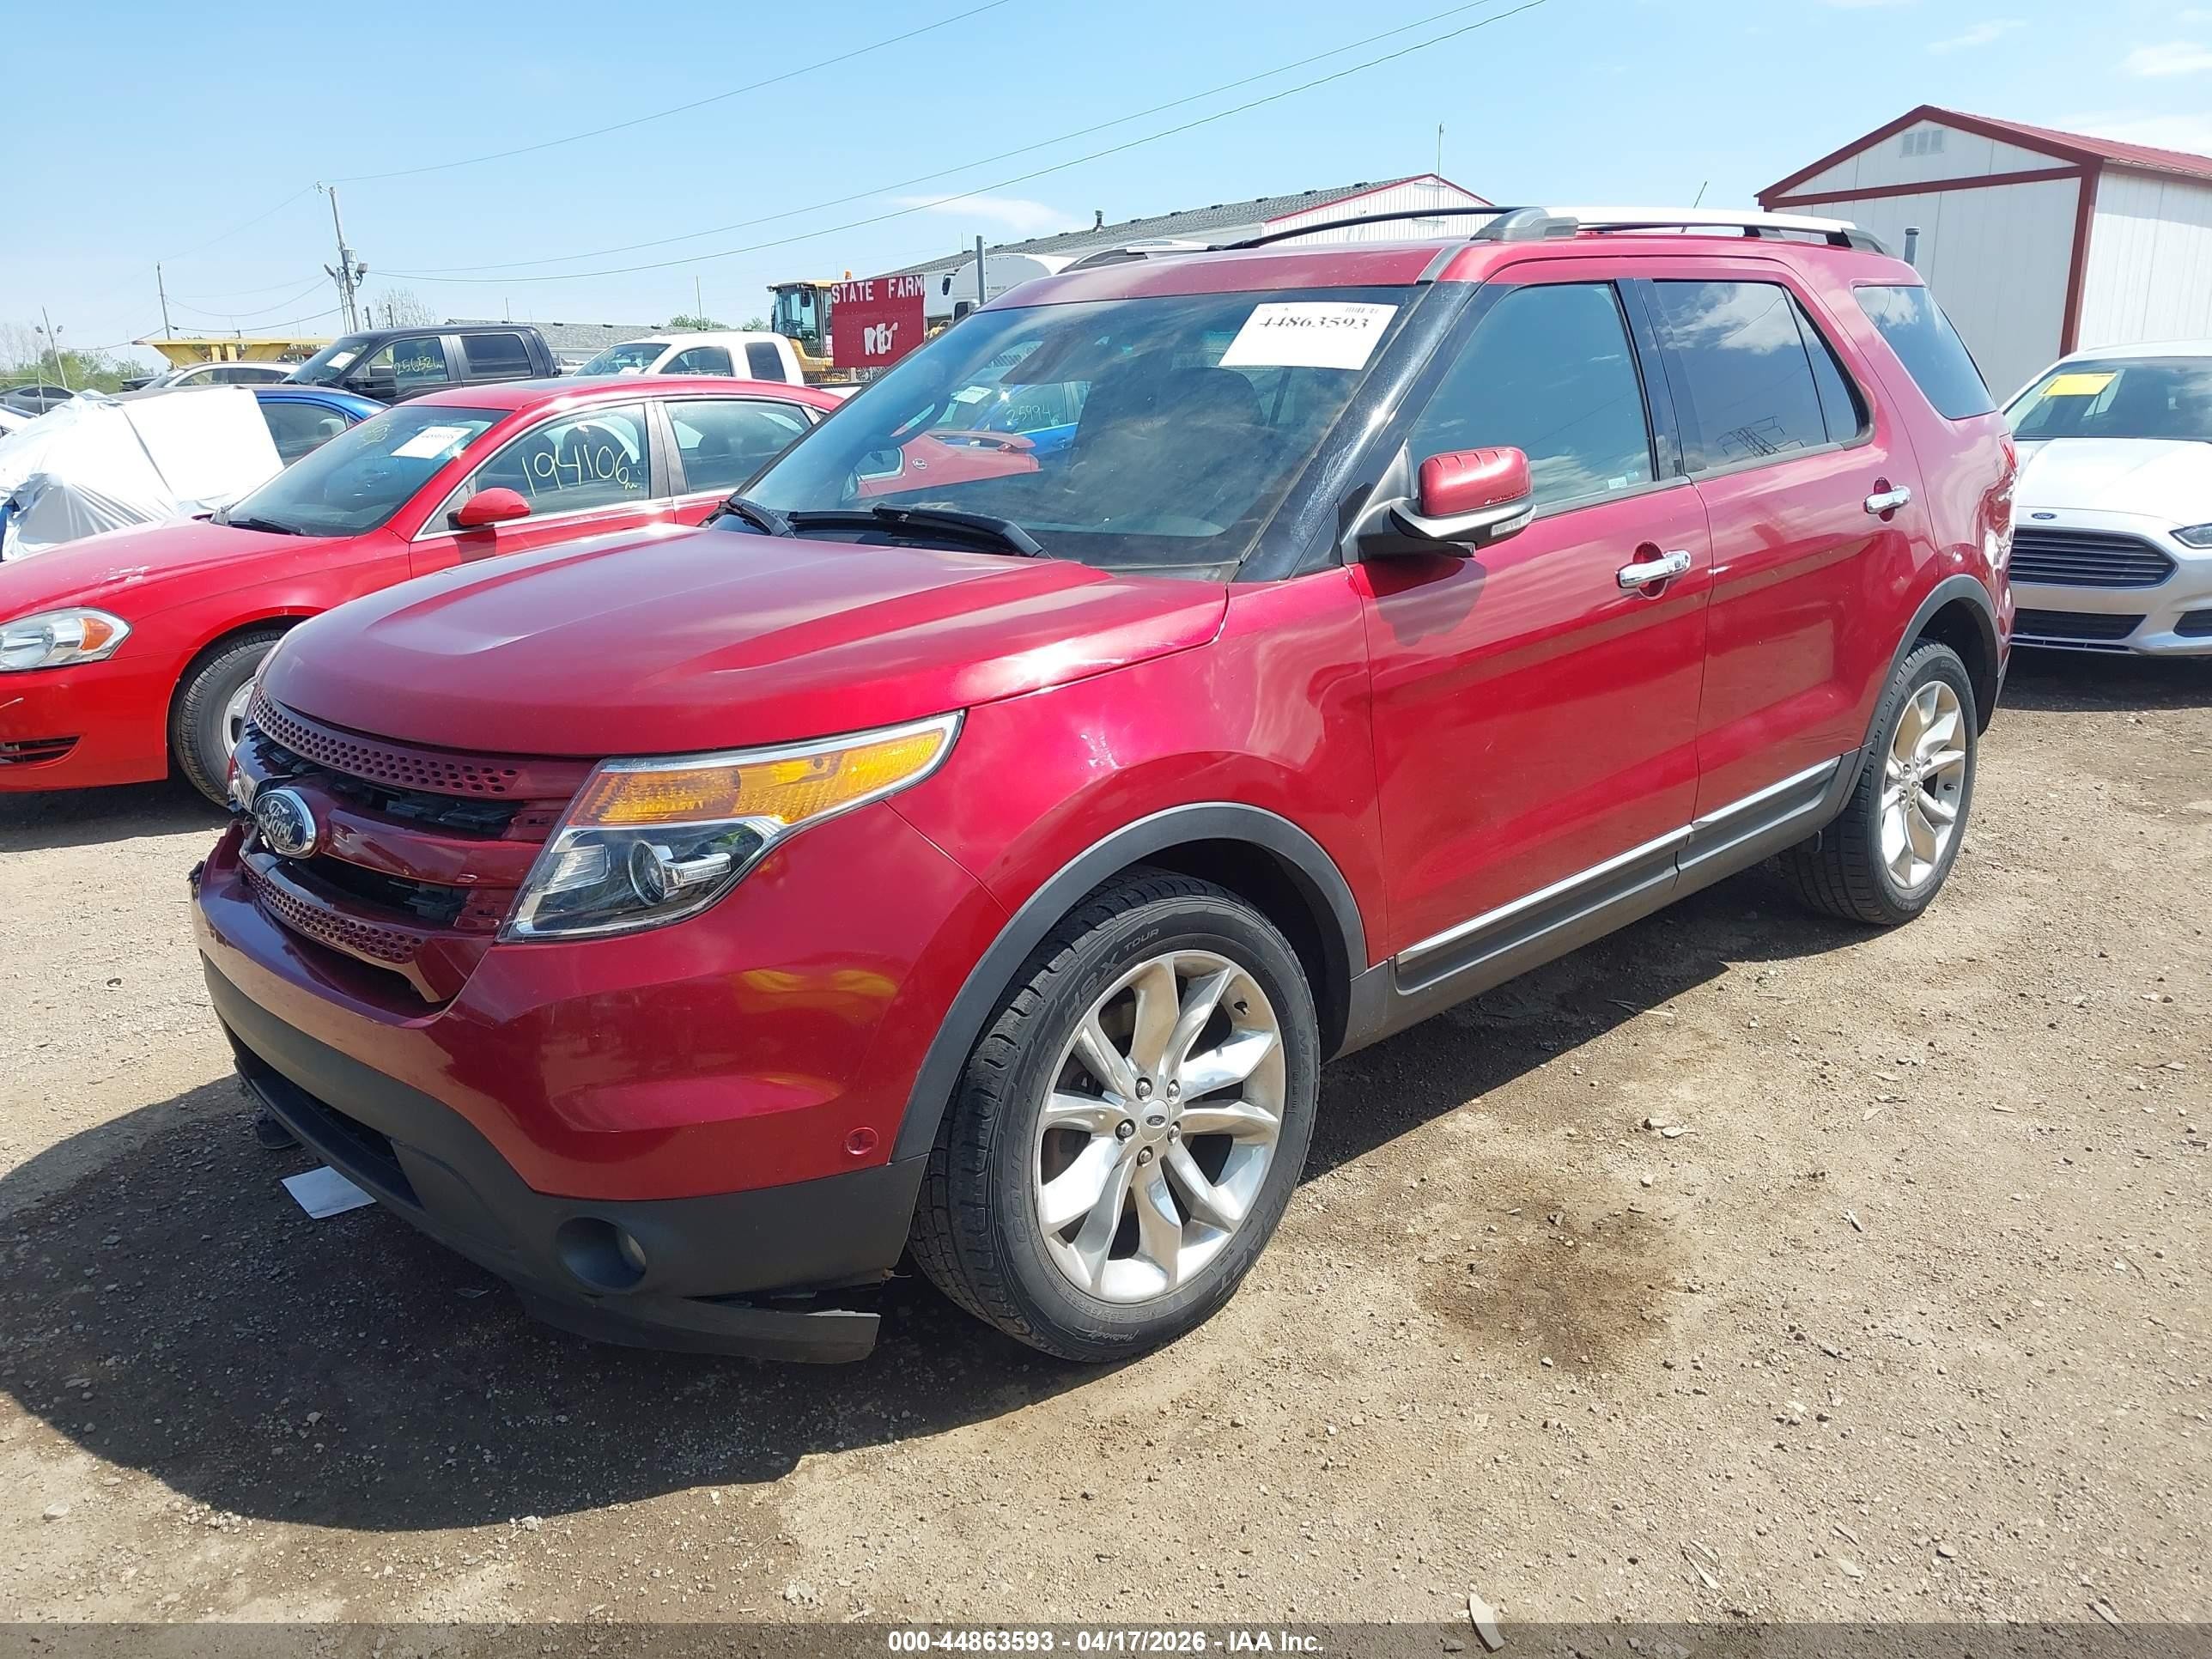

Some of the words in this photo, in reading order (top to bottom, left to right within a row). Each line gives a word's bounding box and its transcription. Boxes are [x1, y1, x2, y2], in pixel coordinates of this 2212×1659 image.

[831, 282, 874, 304] STATE
[888, 275, 926, 299] FARM
[1258, 316, 1370, 330] 44863593
[522, 443, 629, 498] 194106
[1123, 928, 1159, 952] TOUR
